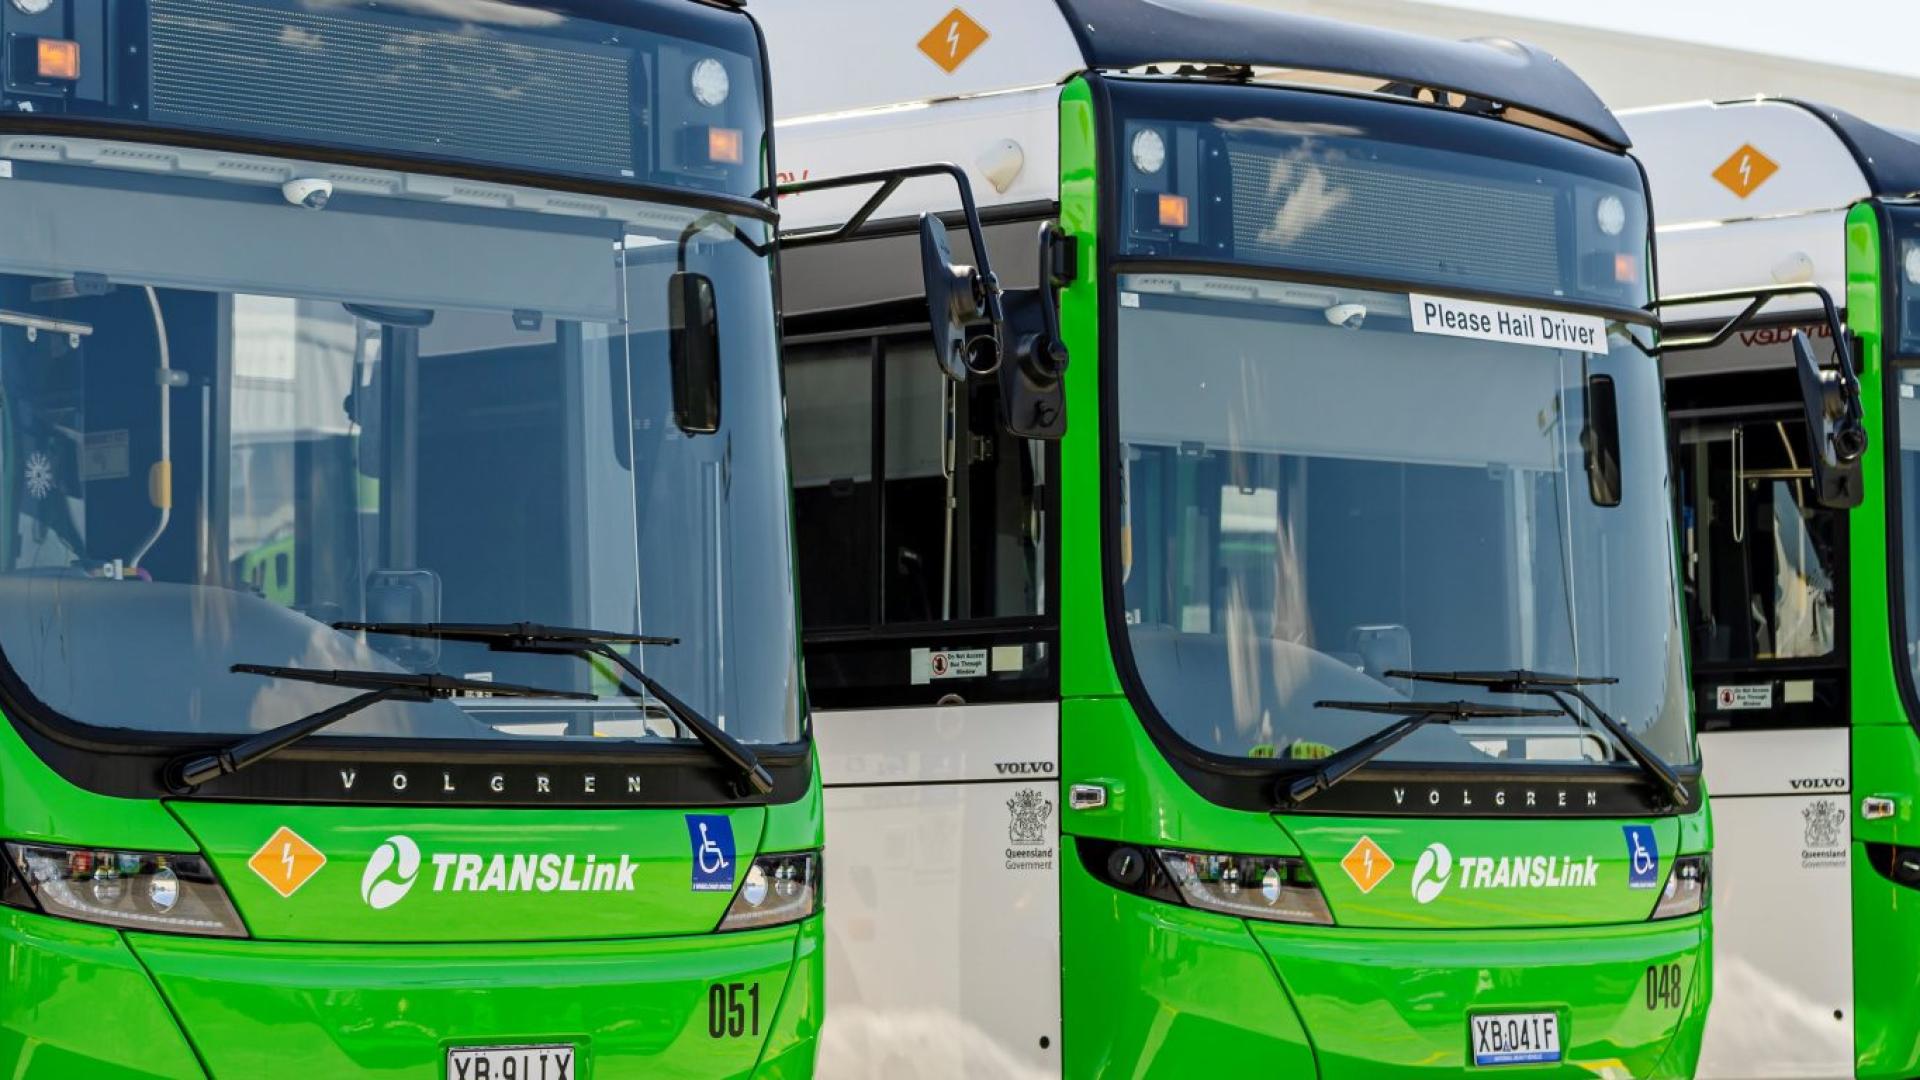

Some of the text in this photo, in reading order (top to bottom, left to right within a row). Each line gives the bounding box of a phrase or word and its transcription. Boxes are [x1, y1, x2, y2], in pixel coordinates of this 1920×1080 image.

[1424, 302, 1595, 346] Please Hail Driver
[994, 762, 1054, 774] VOLVO
[341, 771, 642, 793] VOLGREN
[1790, 777, 1845, 789] VOLVO
[1394, 788, 1597, 806] VOLGREN
[1005, 848, 1053, 859] Queensland
[1801, 849, 1846, 859] Queensland
[432, 854, 639, 891] TRANSLink
[1005, 860, 1052, 870] Government
[1459, 855, 1599, 888] TRANSLink
[1647, 964, 1681, 1010] 048
[709, 983, 759, 1038] 051
